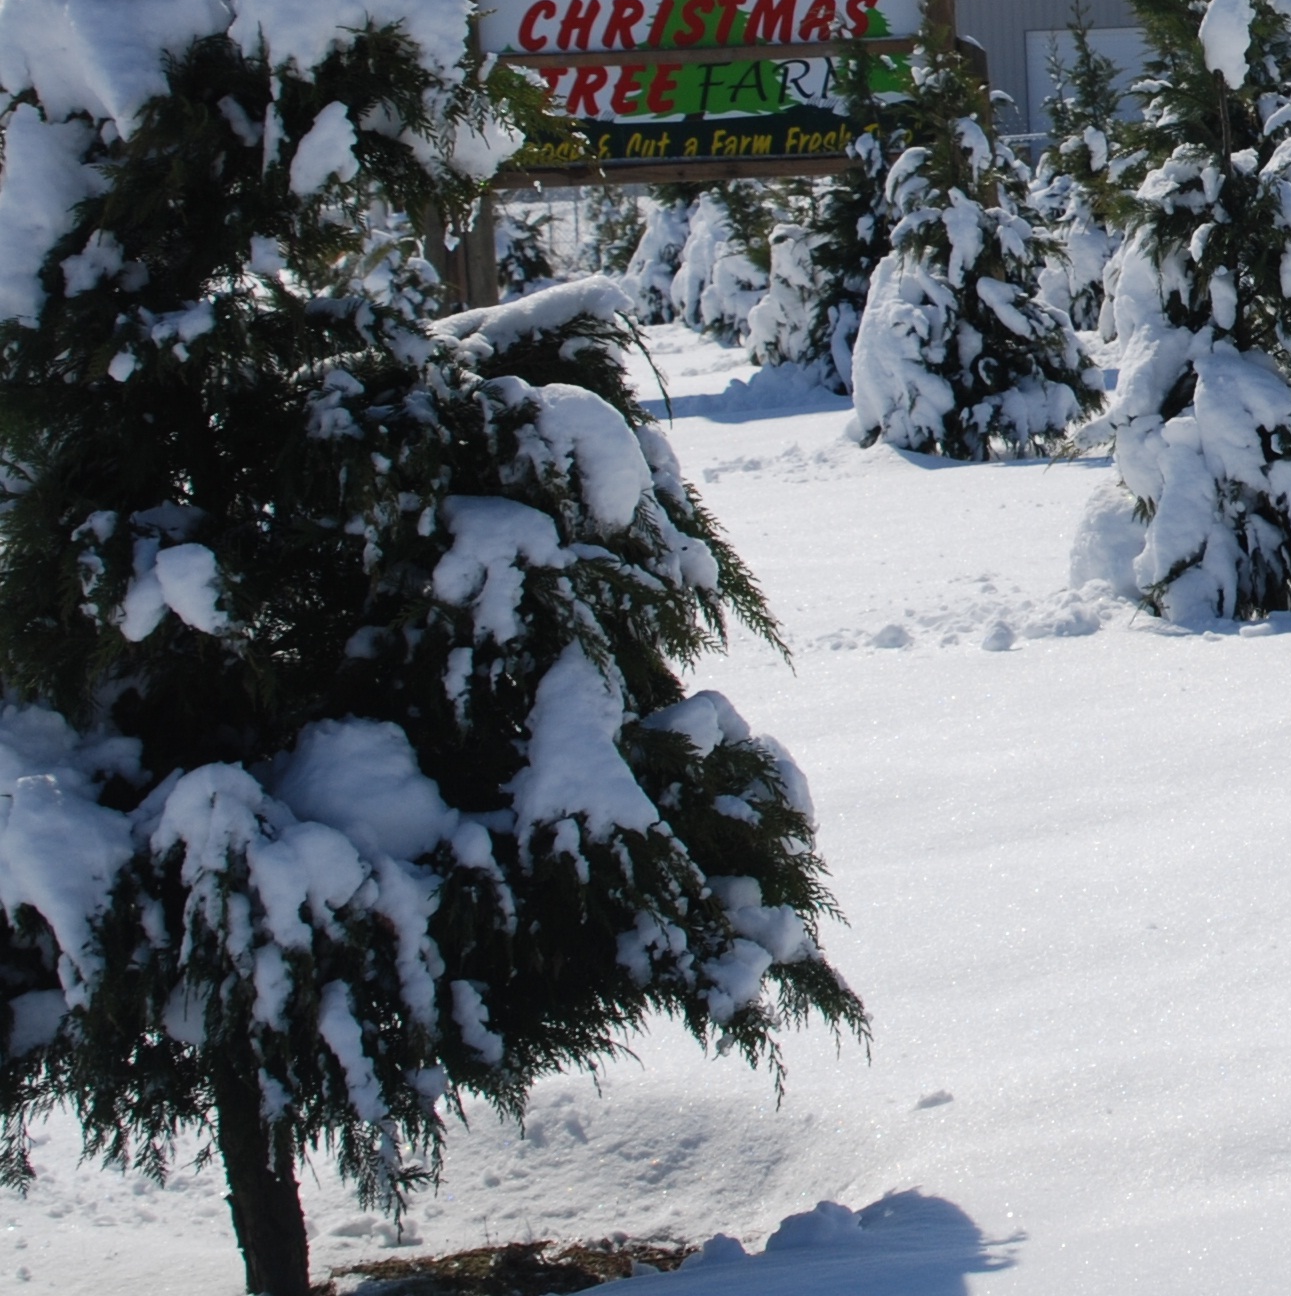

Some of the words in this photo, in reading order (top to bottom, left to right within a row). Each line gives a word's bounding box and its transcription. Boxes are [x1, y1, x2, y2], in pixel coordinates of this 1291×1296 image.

[539, 63, 683, 116] TREE
[626, 131, 671, 158] Cut
[684, 136, 698, 157] a
[711, 129, 773, 156] Farm
[785, 122, 853, 154] Fresh
